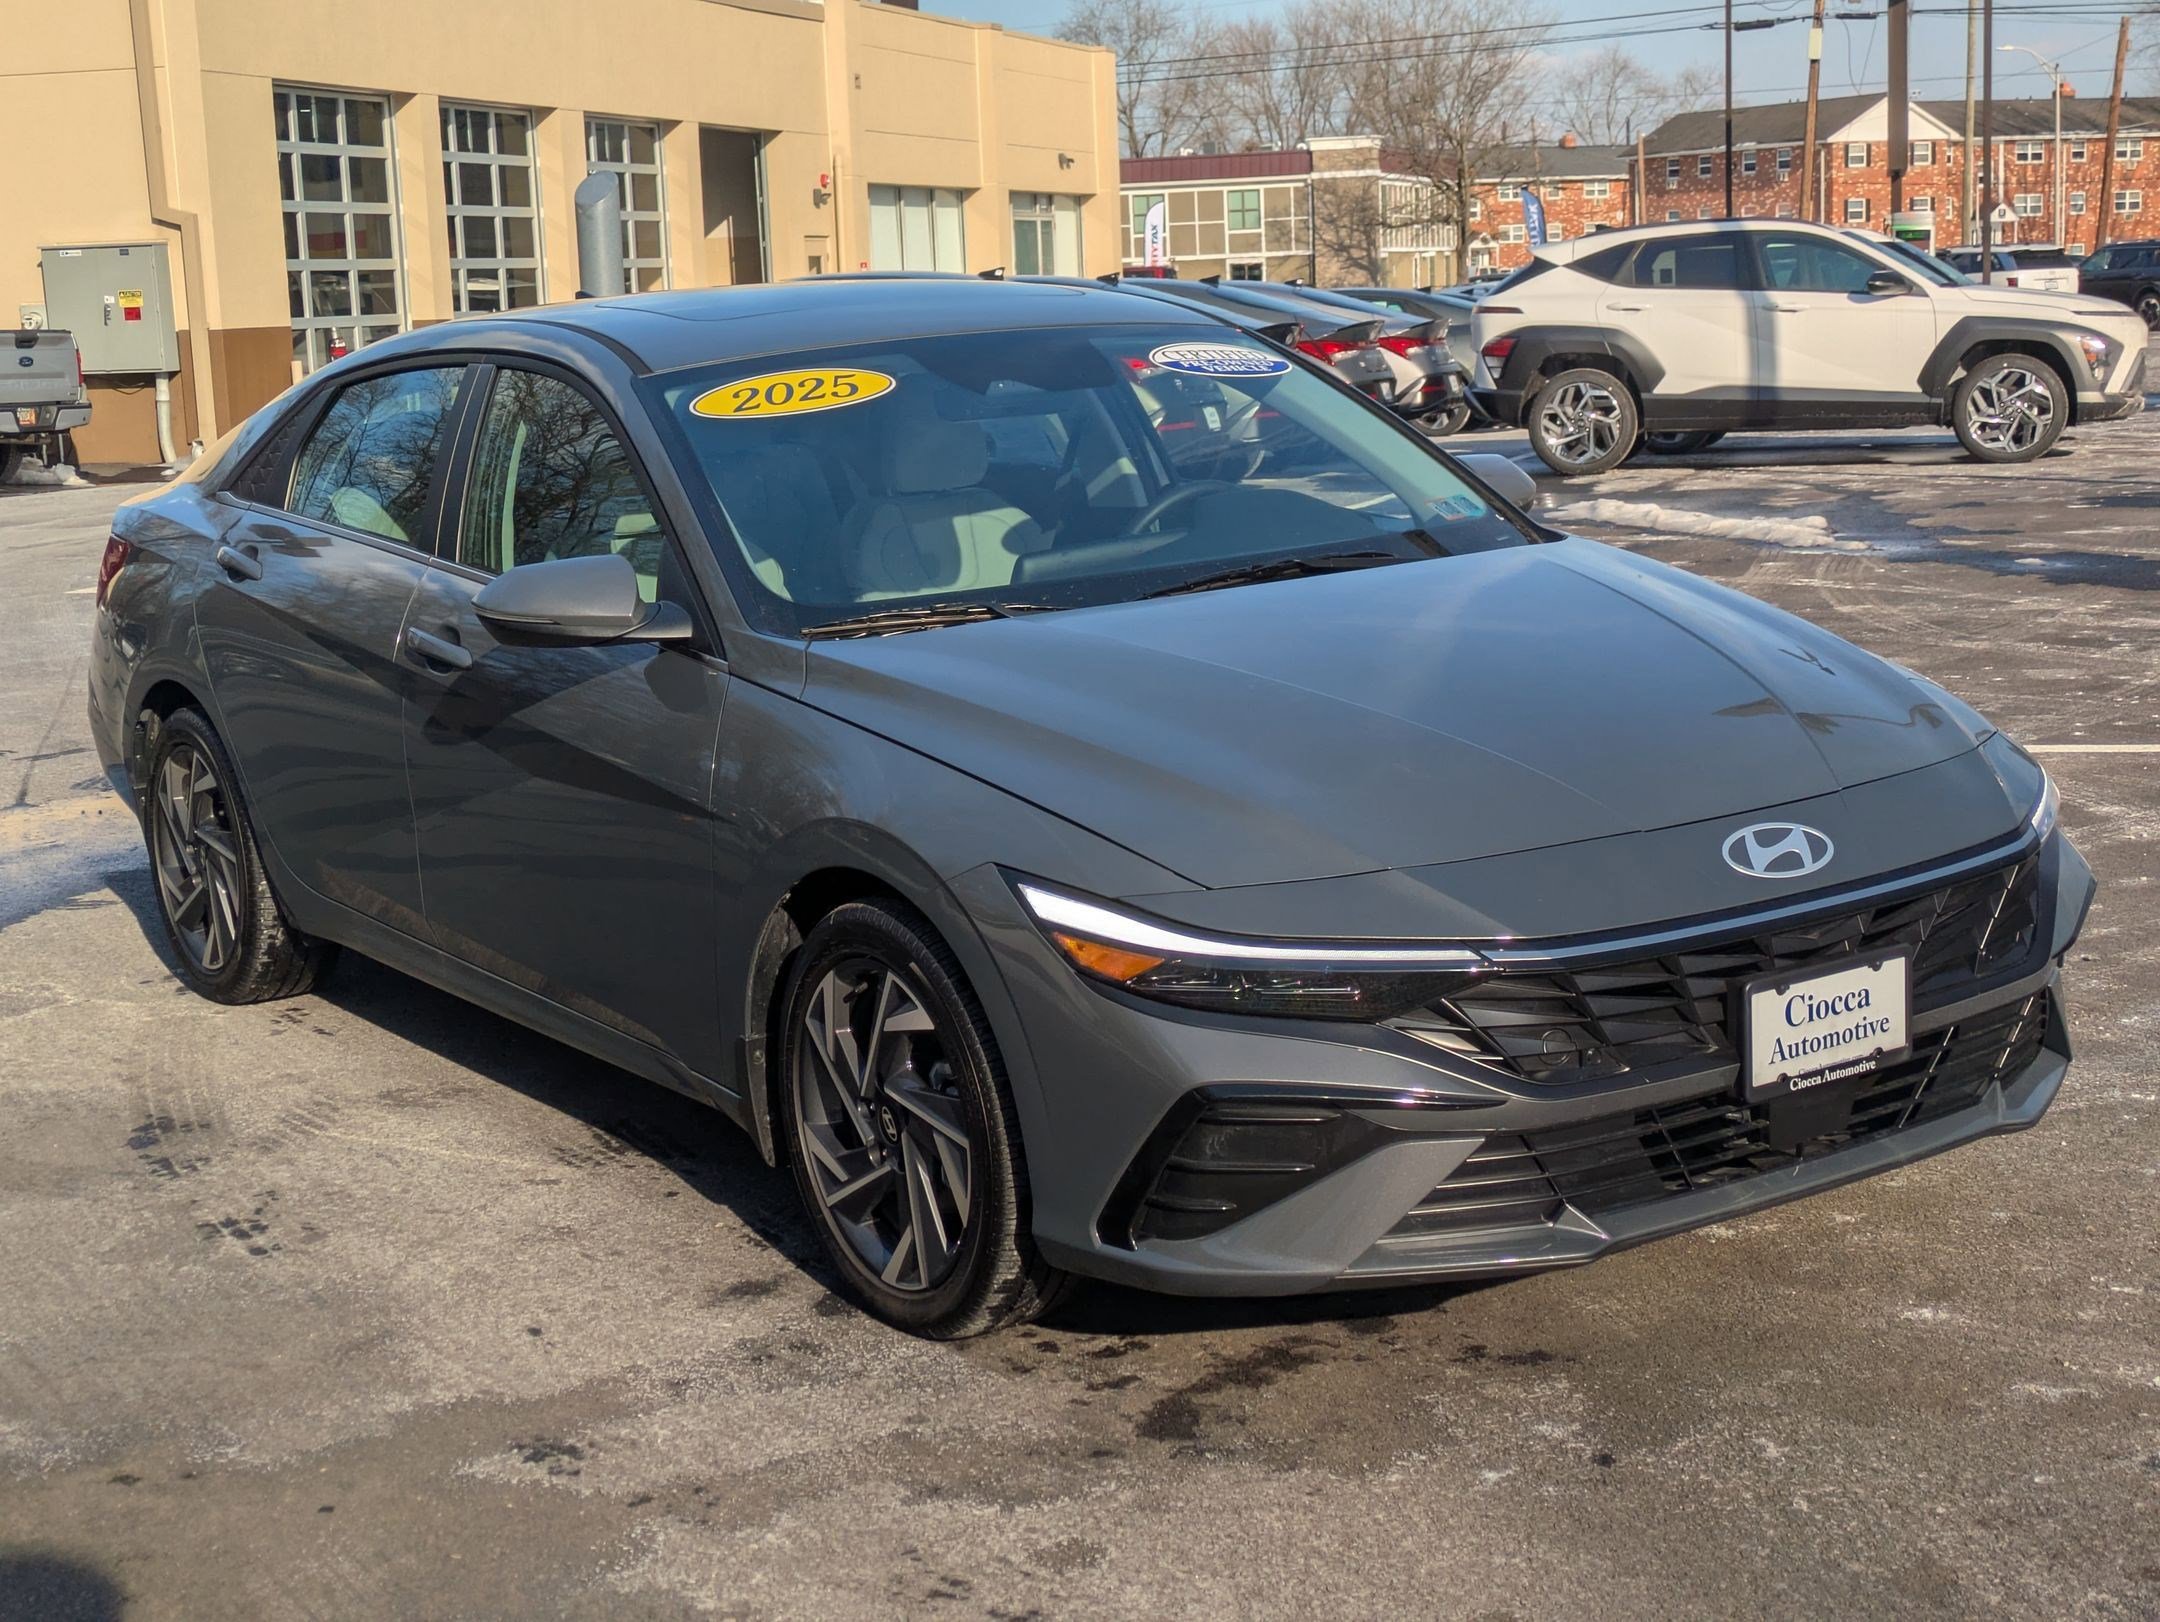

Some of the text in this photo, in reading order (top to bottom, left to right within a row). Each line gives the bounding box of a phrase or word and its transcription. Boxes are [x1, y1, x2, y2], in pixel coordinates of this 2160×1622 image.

[1162, 350, 1268, 361] CERTIFIED
[1179, 359, 1275, 368] PRE-OWNED
[1202, 364, 1271, 372] VEHICLE
[732, 373, 860, 413] 2025
[1785, 987, 1871, 1028] Ciocca
[1769, 1016, 1890, 1065] Automotive
[1790, 1076, 1821, 1091] Ciocca
[1822, 1060, 1876, 1082] Automotive
